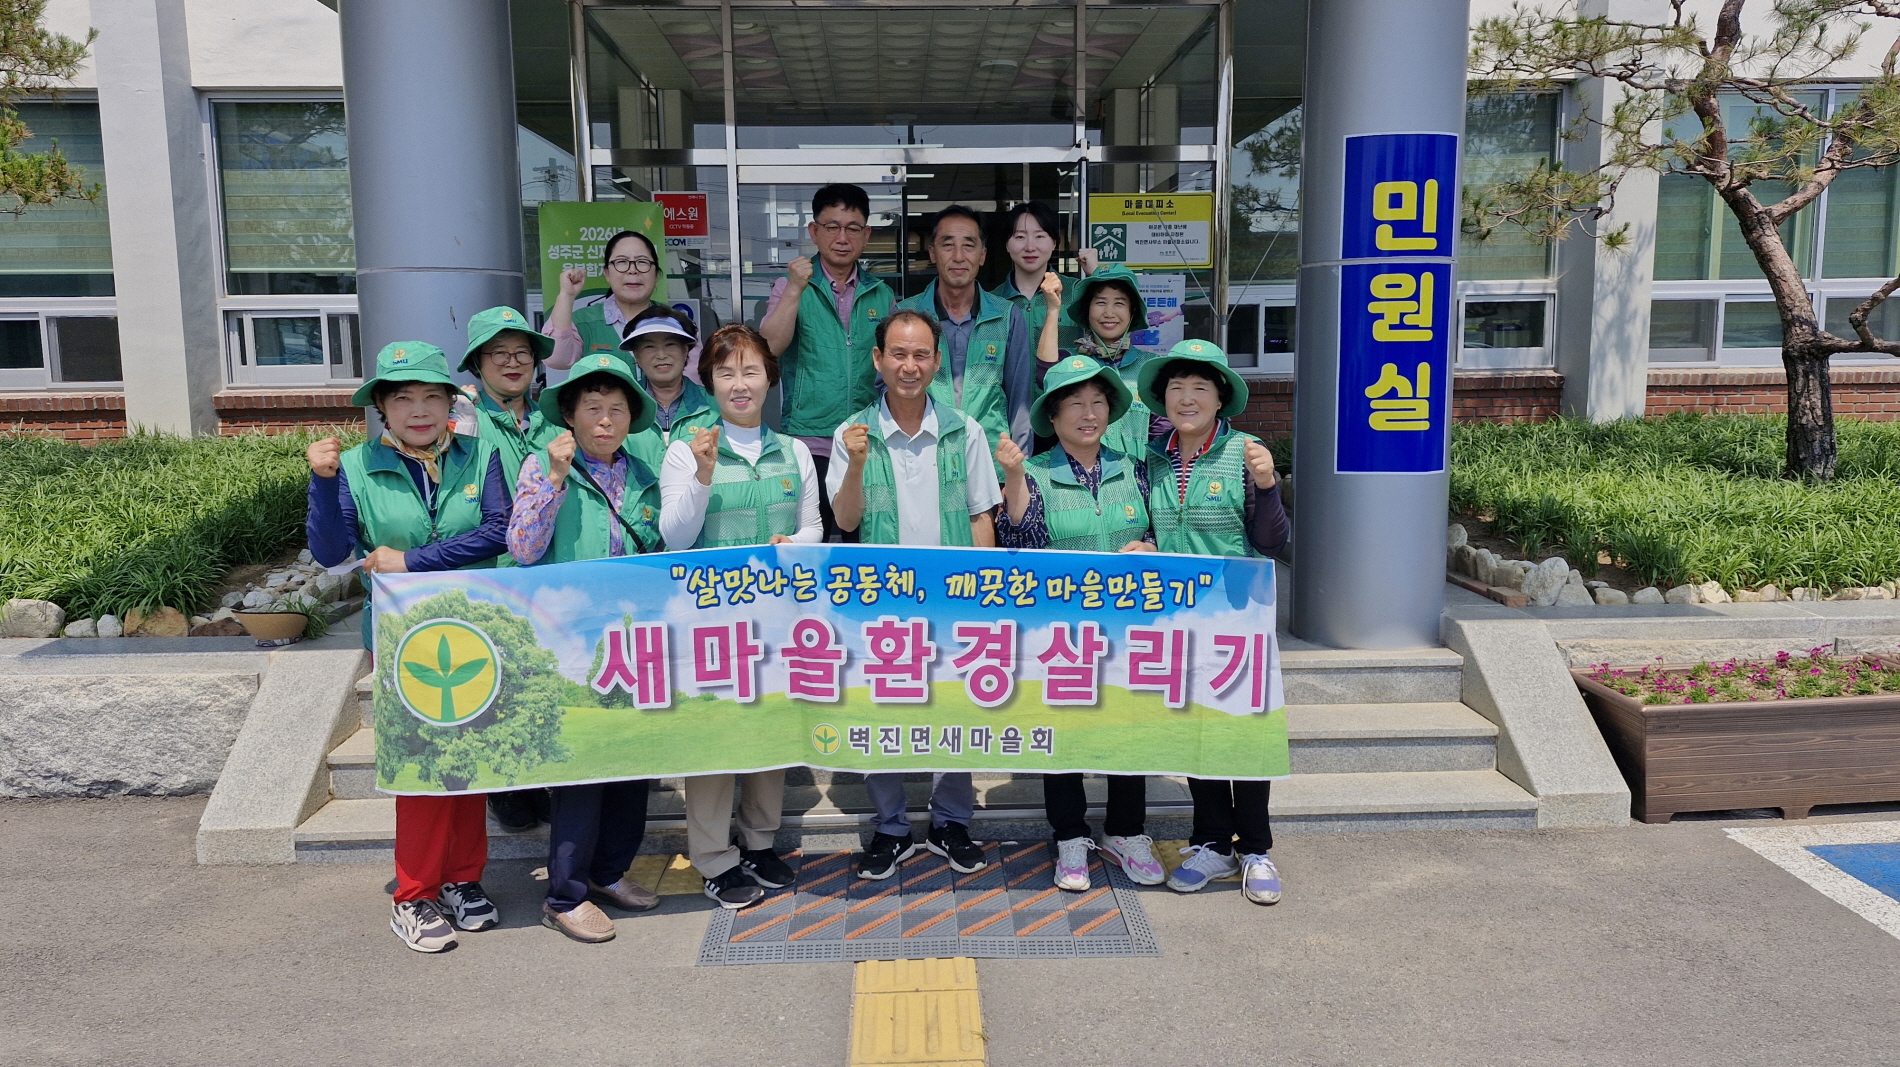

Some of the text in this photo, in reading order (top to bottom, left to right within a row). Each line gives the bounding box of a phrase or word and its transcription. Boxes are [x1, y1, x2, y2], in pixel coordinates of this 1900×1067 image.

[663, 207, 699, 221] 에스원
[1124, 199, 1174, 209] 마을대피소
[547, 244, 585, 260] 성주군
[1364, 178, 1439, 431] 민원실
[1205, 495, 1222, 503] SMU
[671, 564, 1213, 611] "살맛나는 공동체, 깨끗한 마을만들기"
[595, 618, 1264, 708] 새마을환경살리기
[848, 725, 1053, 755] 벽진면새마을회
